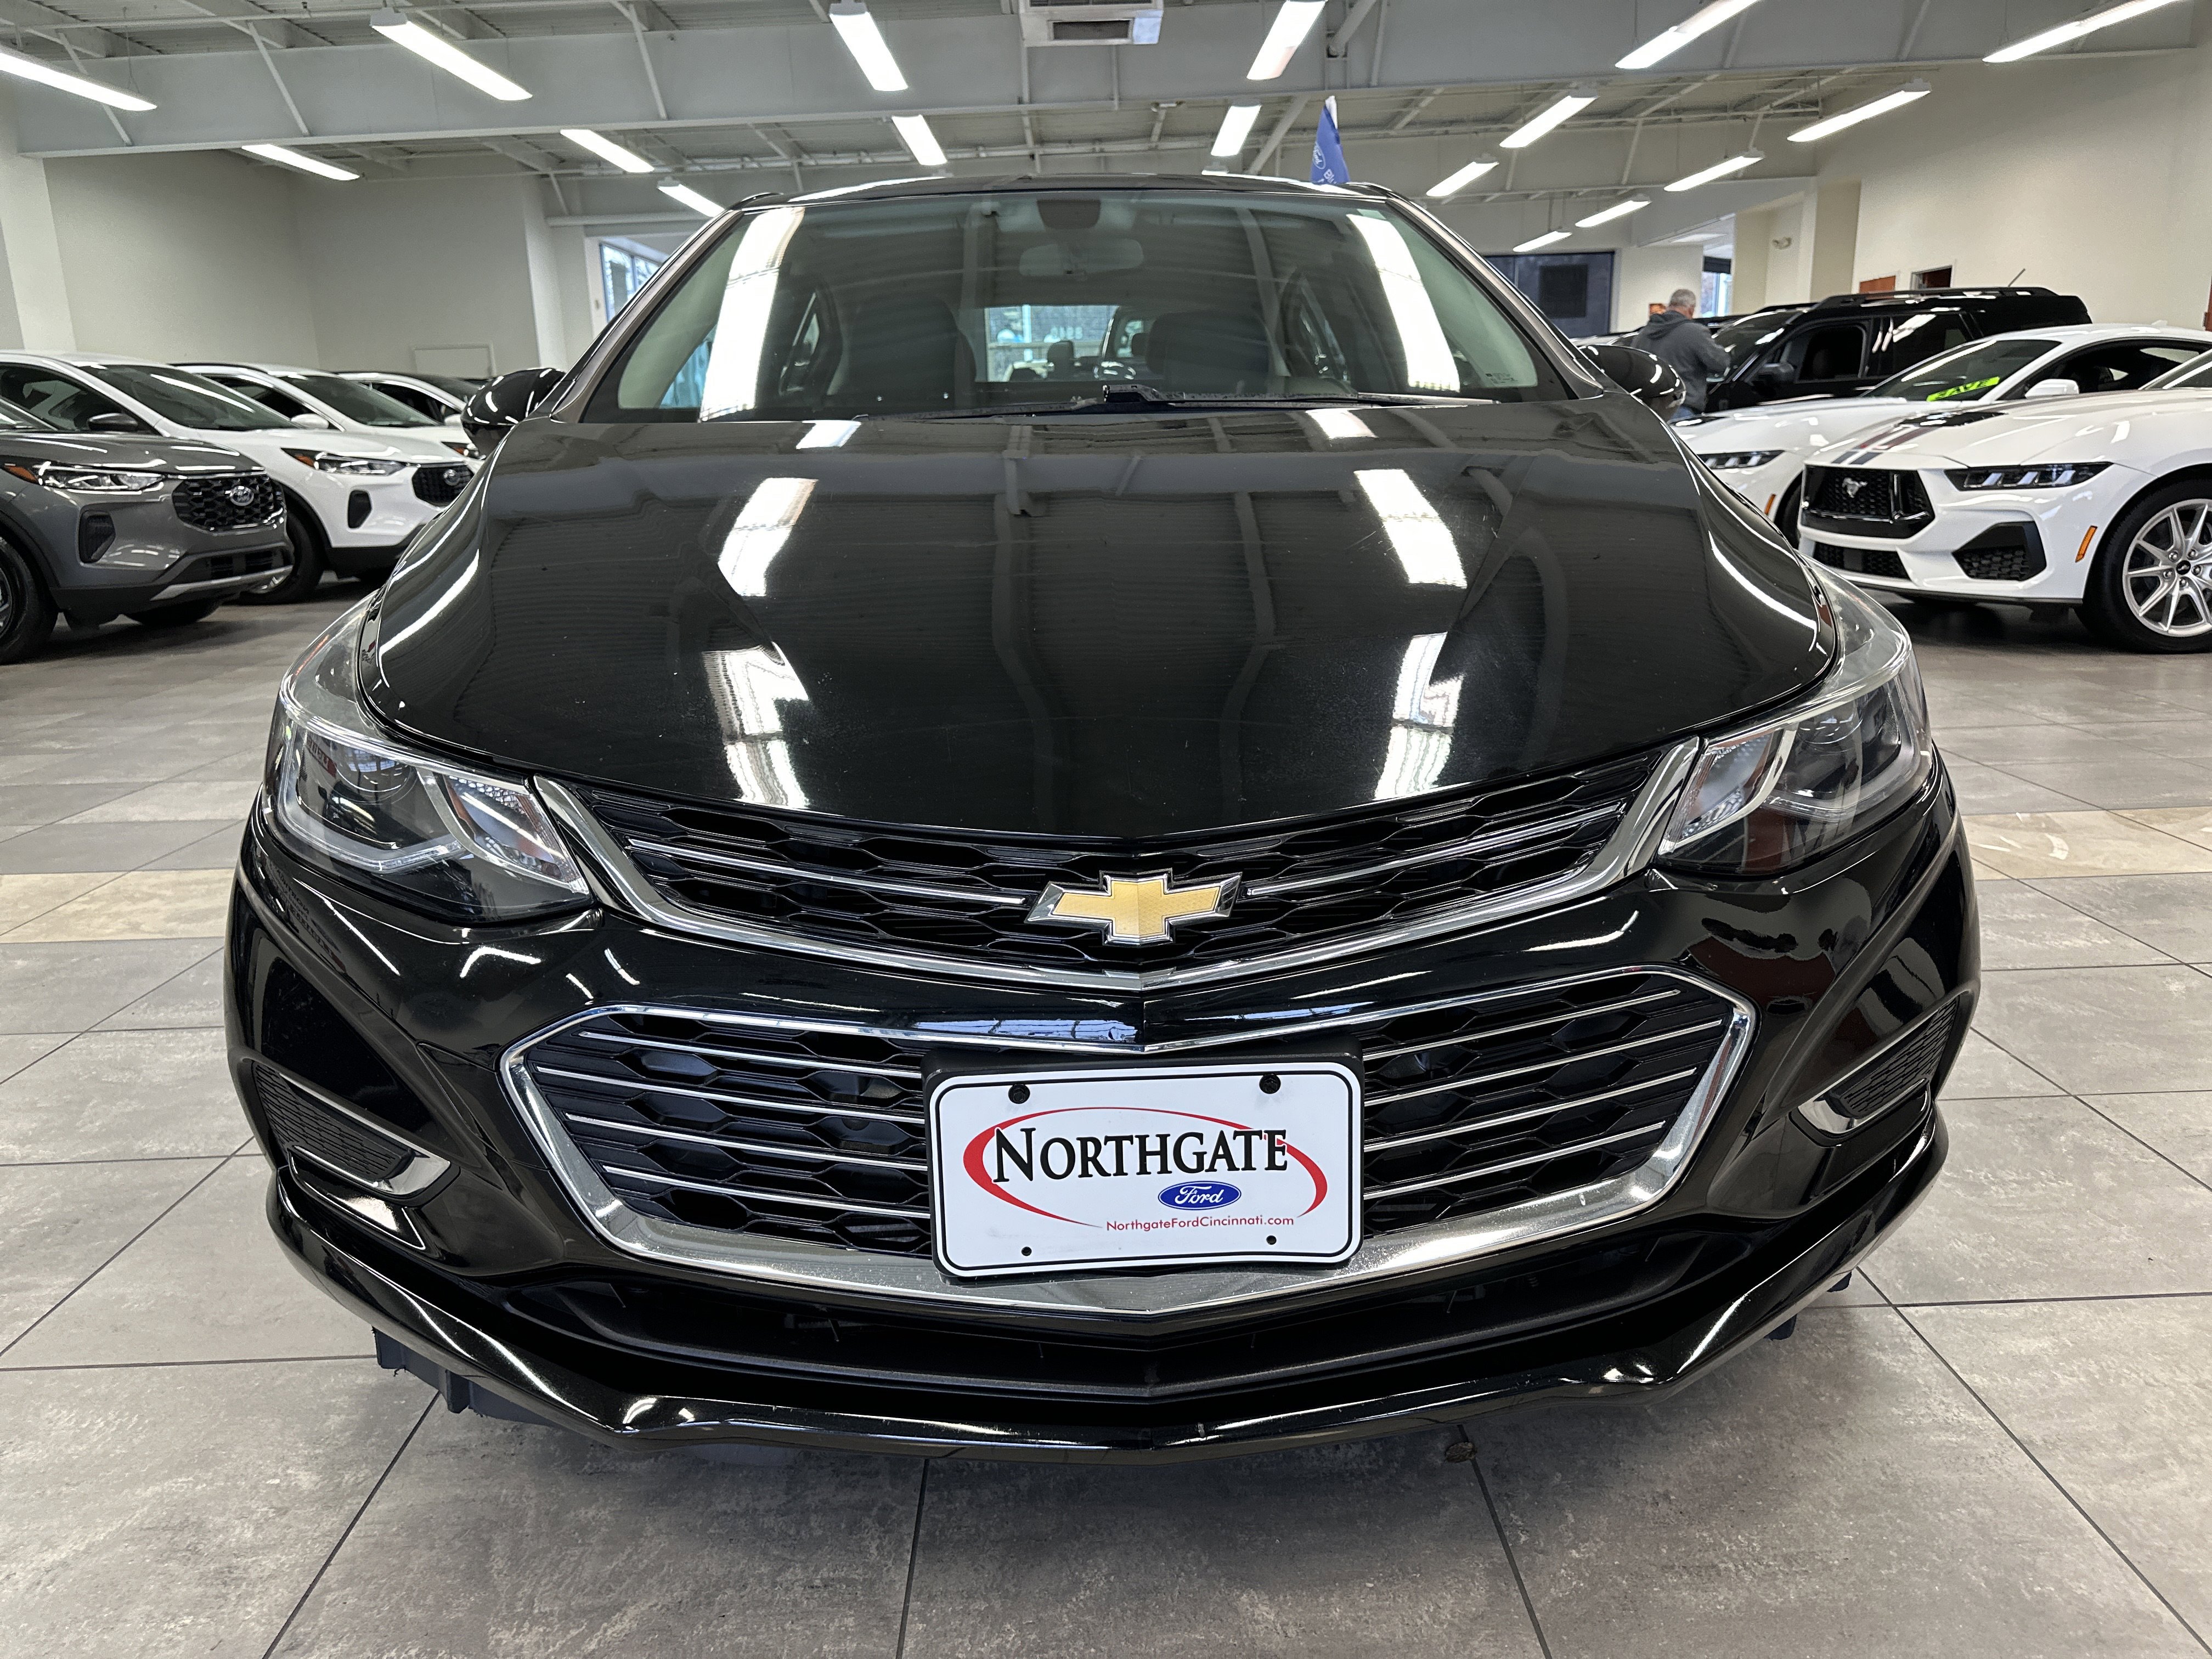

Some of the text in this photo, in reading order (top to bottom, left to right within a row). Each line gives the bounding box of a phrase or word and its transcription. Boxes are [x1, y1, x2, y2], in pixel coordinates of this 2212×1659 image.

[992, 1127, 1288, 1183] NORTHGATE
[1174, 1185, 1224, 1204] Ford
[1107, 1214, 1294, 1232] NorthgateFordCincinnati.com
